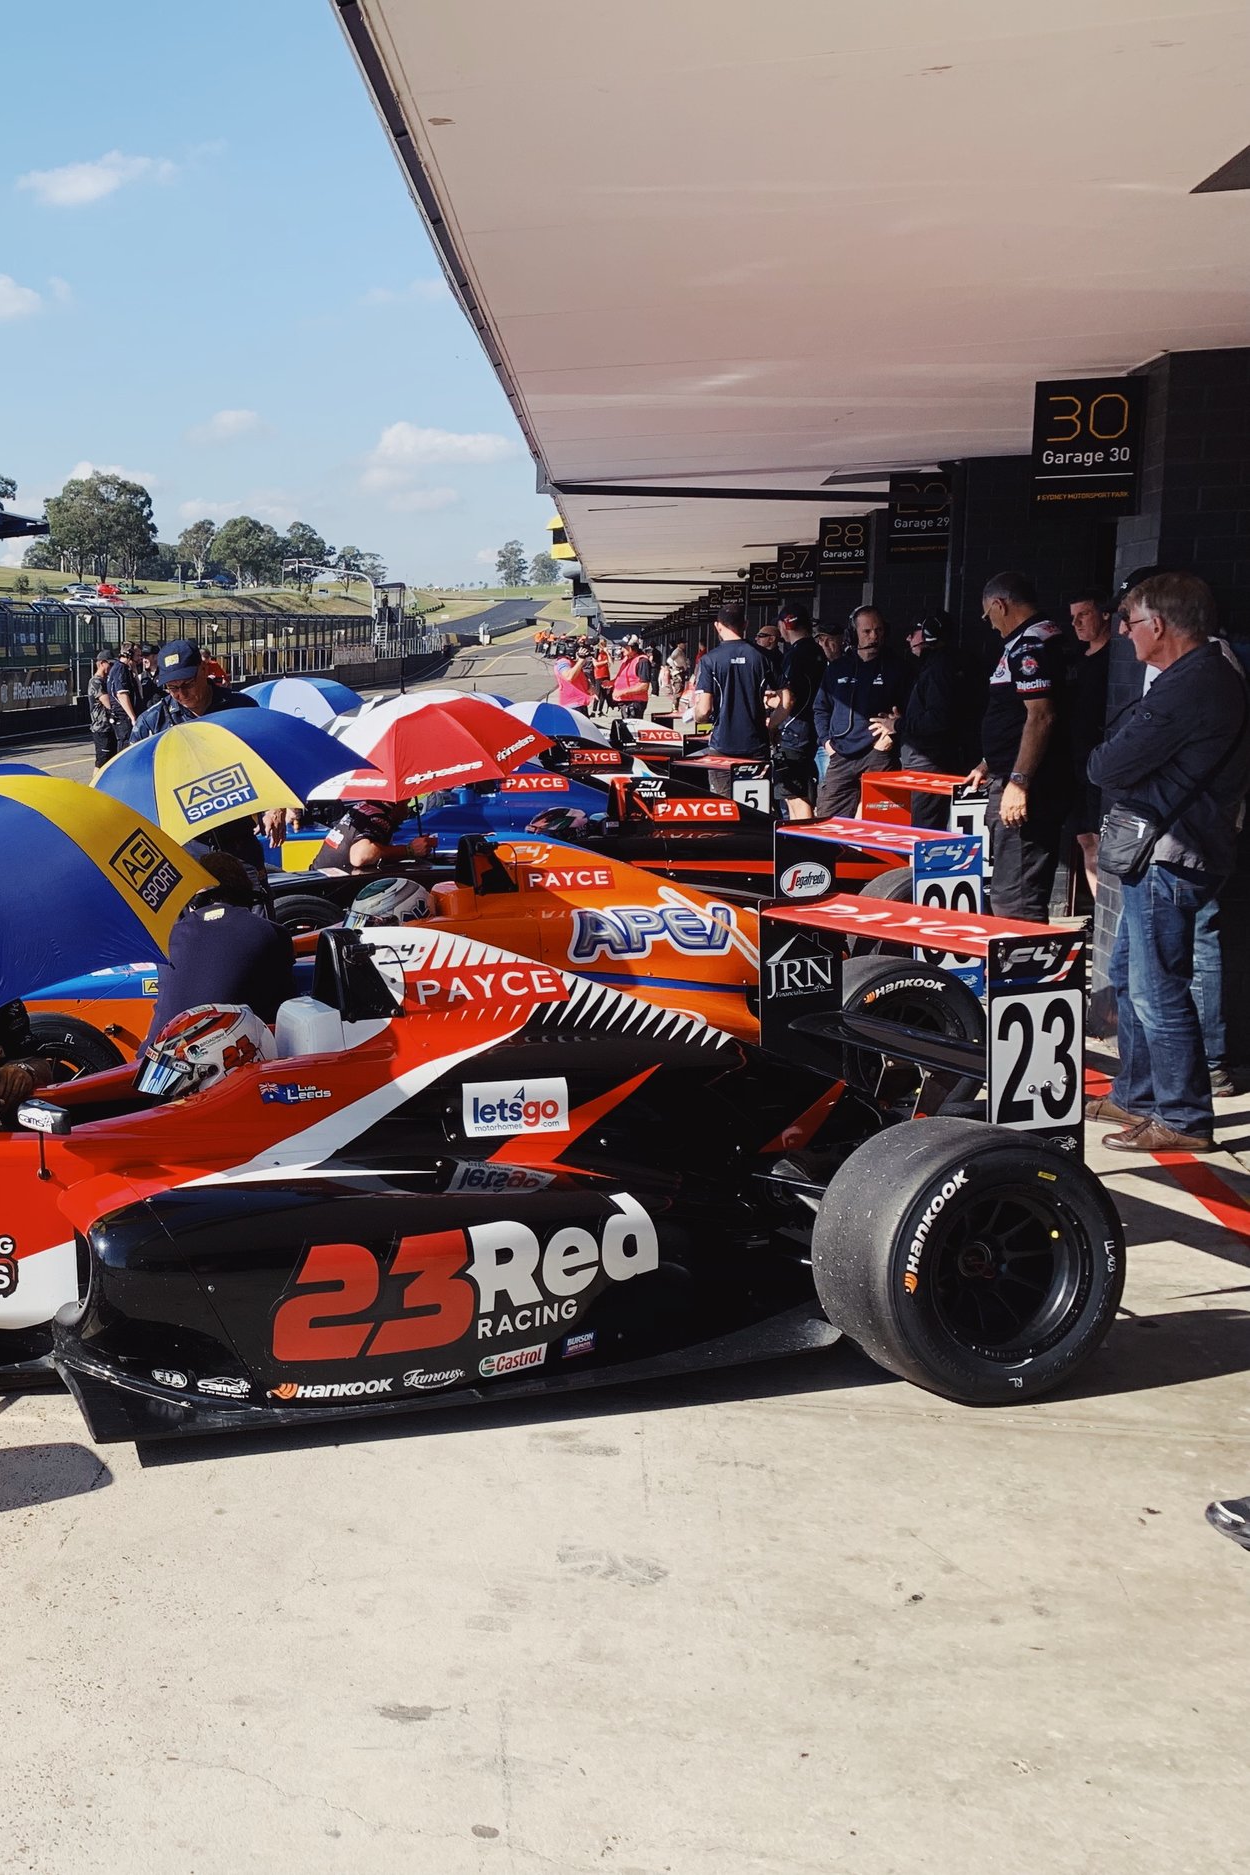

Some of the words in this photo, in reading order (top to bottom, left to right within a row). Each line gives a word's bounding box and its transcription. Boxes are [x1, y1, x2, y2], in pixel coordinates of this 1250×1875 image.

[1047, 394, 1128, 441] 30
[1042, 450, 1104, 466] Garage
[1109, 447, 1130, 462] 30
[1068, 492, 1110, 500] MOTORSPORT
[894, 518, 934, 529] Garage
[937, 517, 950, 527] 29
[824, 524, 864, 547] 28
[782, 551, 810, 570] 27
[823, 550, 852, 559] Garage
[854, 549, 865, 557] 28
[753, 566, 778, 583] 26
[780, 571, 803, 580] Garage
[805, 570, 814, 578] 27
[723, 585, 742, 598] 25
[13, 680, 67, 700] #RaceOfficialsARDC
[640, 731, 680, 740] PAYCE
[574, 752, 619, 762] PAYCE
[404, 761, 484, 785] alpinestars
[186, 766, 249, 806] AGI
[506, 778, 564, 789] PAYCE
[188, 786, 253, 821] SPORT
[641, 791, 667, 799] WALLS
[744, 790, 759, 811] 5
[657, 803, 734, 817] PAYCE
[121, 838, 161, 887] AGI
[142, 862, 177, 907] SPORT
[528, 870, 609, 888] PAYCE
[787, 869, 826, 892] Segafredo
[767, 957, 832, 999] JRN
[416, 970, 558, 1006] PAYCE
[175, 1063, 188, 1071] BELL
[997, 997, 1078, 1125] 23
[287, 1089, 331, 1100] Leeds
[297, 1084, 316, 1092] Luis
[475, 1123, 522, 1132] motorhomes
[477, 1299, 579, 1340] RACING
[567, 1332, 594, 1346] BURSON
[496, 1350, 542, 1372] Castrol
[155, 1372, 184, 1385] FIA
